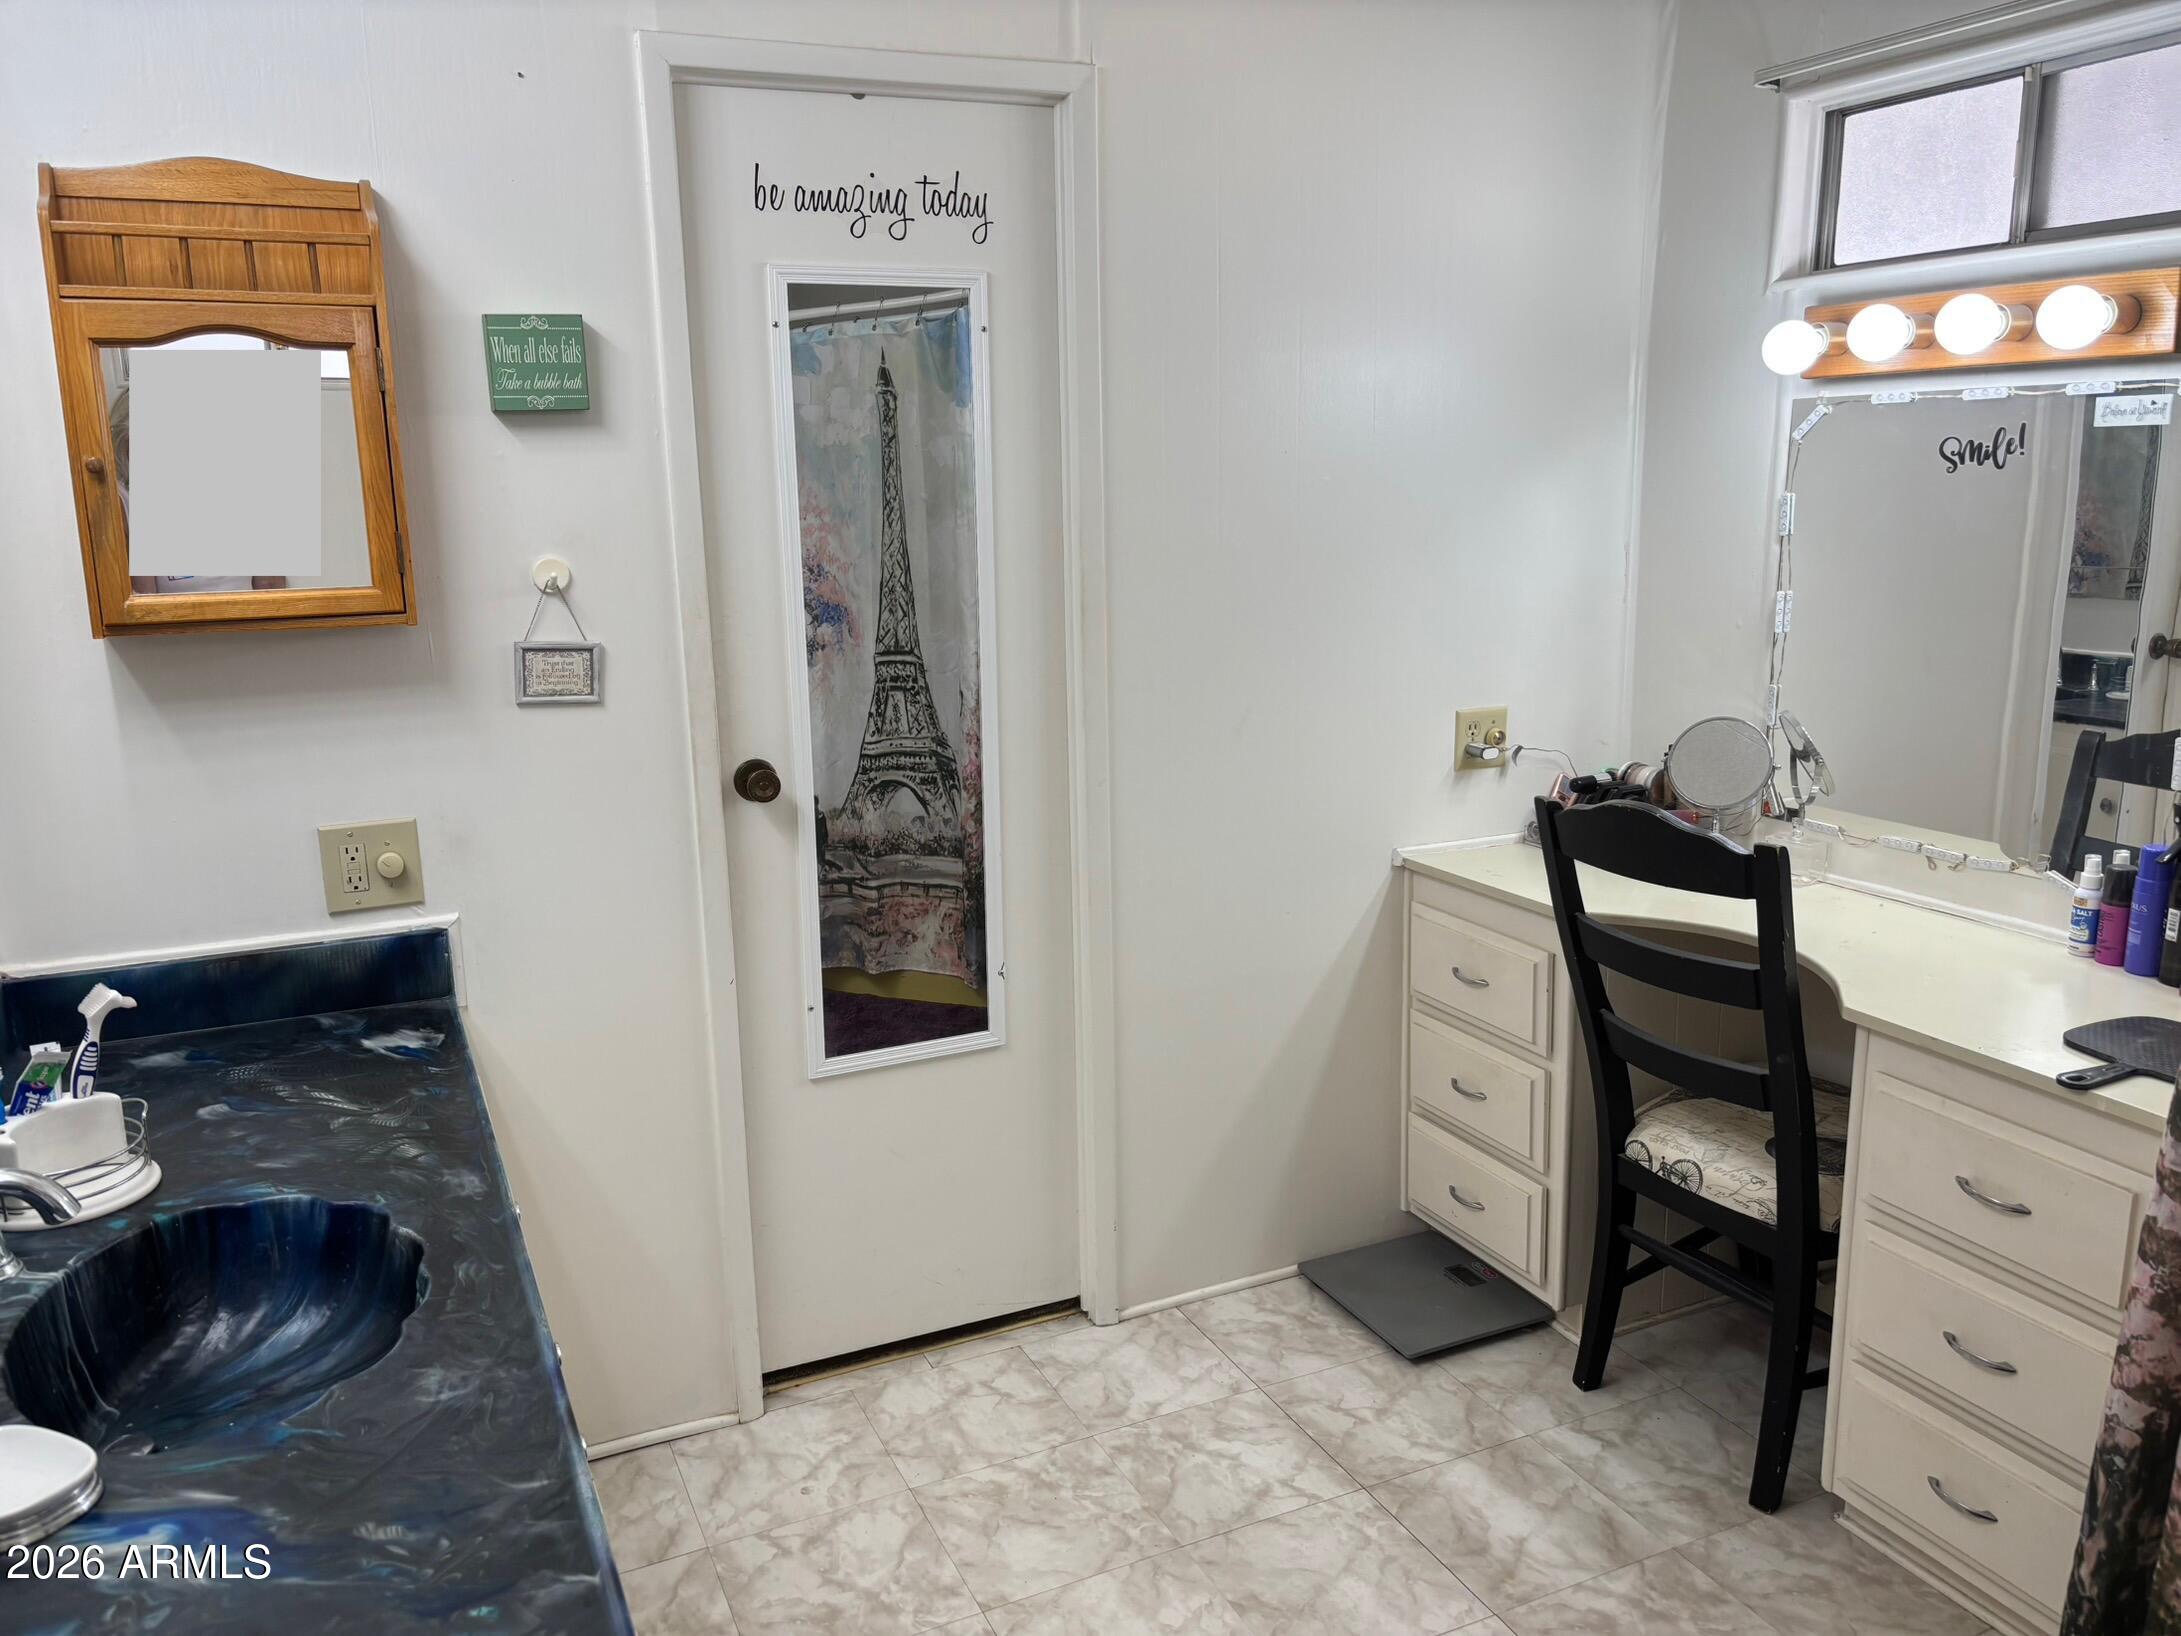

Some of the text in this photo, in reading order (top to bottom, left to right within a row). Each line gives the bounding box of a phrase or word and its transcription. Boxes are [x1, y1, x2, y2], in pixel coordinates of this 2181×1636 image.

[754, 162, 994, 244] be amazing today
[490, 336, 582, 364] When all else fails
[495, 368, 583, 391] Take a bubble bath
[1938, 422, 2027, 474] Smile!
